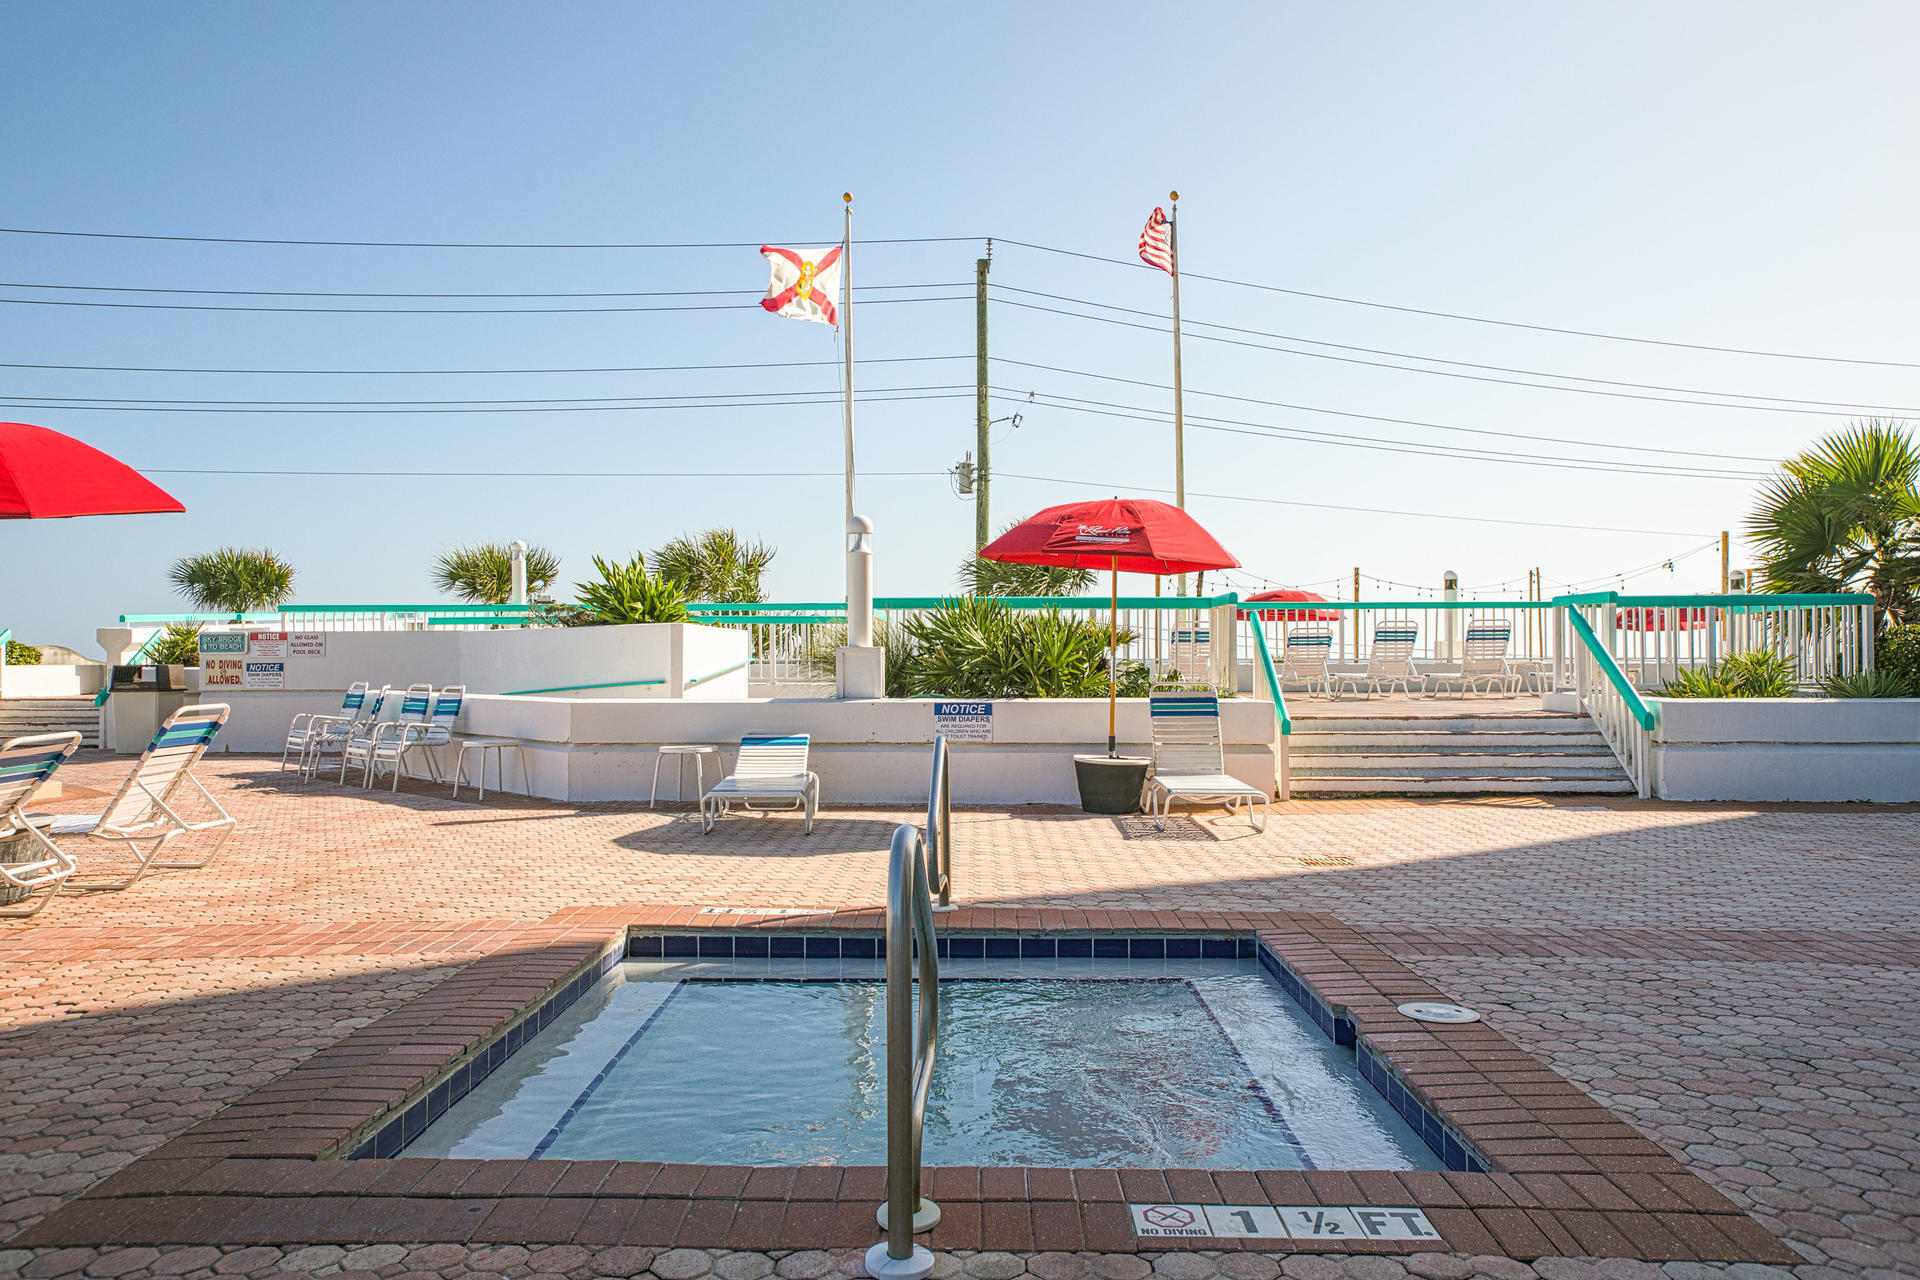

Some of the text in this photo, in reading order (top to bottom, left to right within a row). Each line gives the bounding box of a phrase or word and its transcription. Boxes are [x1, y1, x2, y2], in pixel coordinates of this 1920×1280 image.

[205, 659, 242, 669] NO DIVING
[249, 664, 280, 672] NOTICE
[208, 675, 240, 685] ALLOWED
[941, 704, 986, 714] NOTICE
[1230, 1210, 1259, 1233] 1
[1357, 1211, 1434, 1236] FT.
[1162, 1228, 1208, 1236] DIVING
